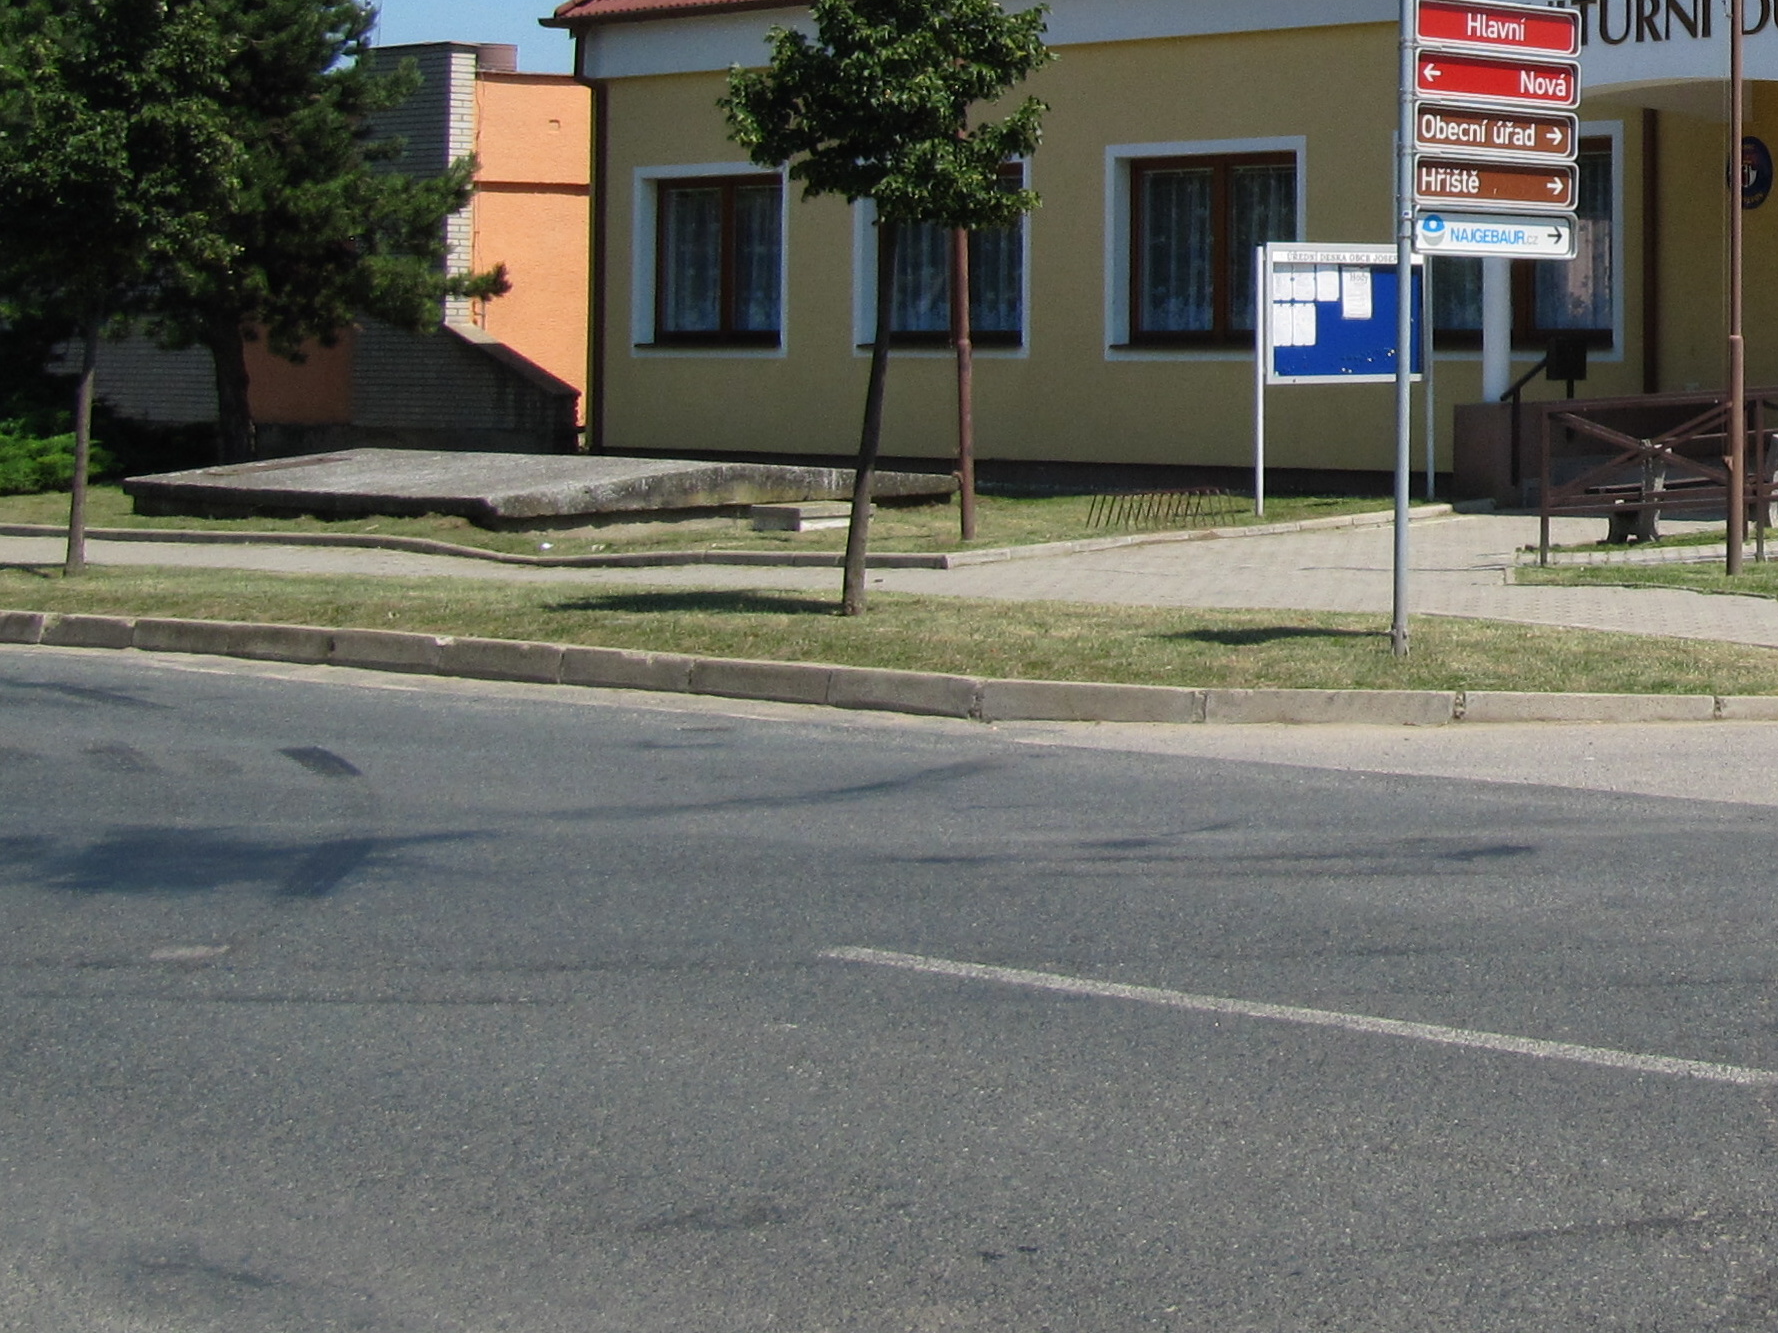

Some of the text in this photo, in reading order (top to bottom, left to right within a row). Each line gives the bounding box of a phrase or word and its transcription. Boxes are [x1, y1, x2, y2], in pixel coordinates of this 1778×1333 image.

[1467, 13, 1526, 42] Hlavní
[1520, 70, 1567, 97] Nová
[1421, 114, 1536, 147] Obecní úřad
[1421, 167, 1480, 194] Hřiště
